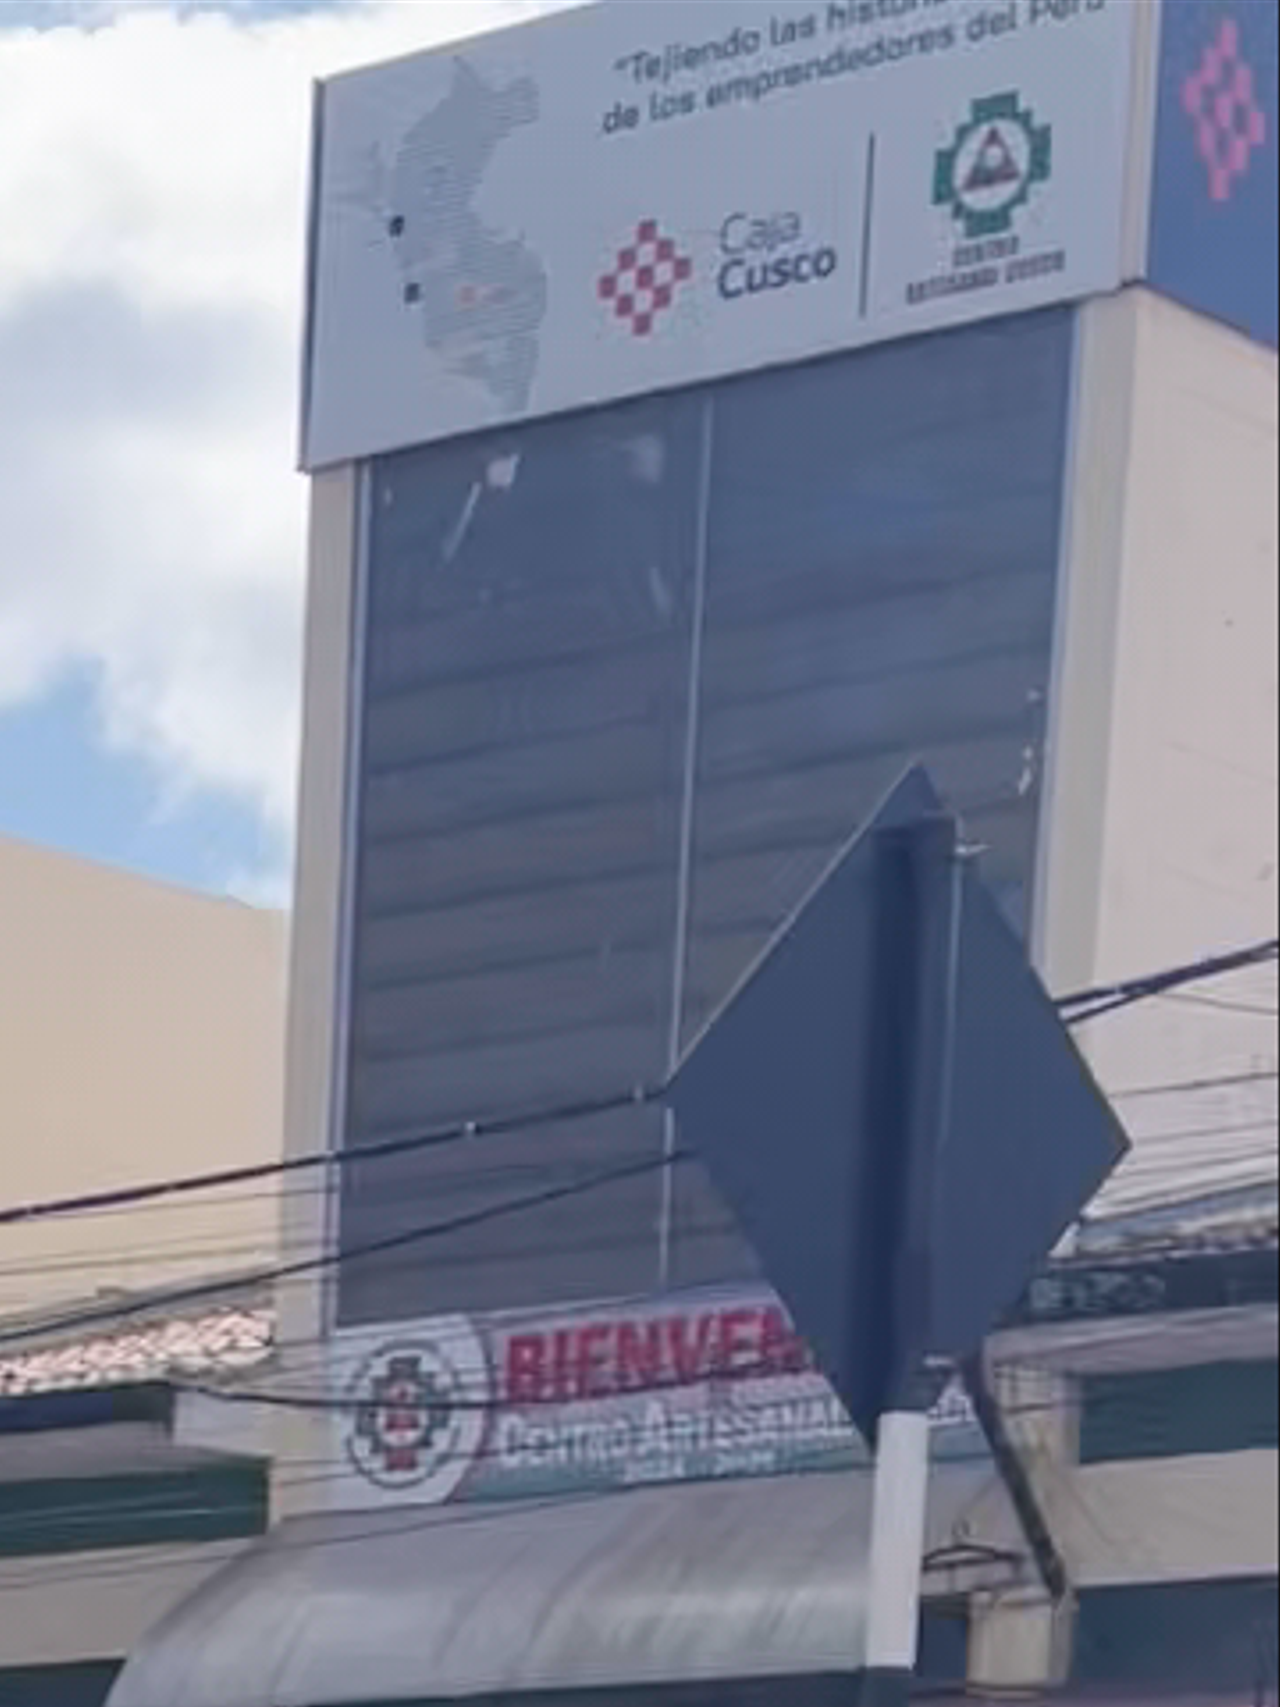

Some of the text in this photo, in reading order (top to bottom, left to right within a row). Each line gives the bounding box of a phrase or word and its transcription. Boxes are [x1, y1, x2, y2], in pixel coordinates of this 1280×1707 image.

[769, 14, 816, 47] las
[602, 102, 640, 134] de
[649, 91, 697, 121] los
[706, 23, 956, 108] emprendedores
[966, 3, 1017, 41] del
[719, 211, 802, 254] Caja
[716, 247, 837, 299] Cusco
